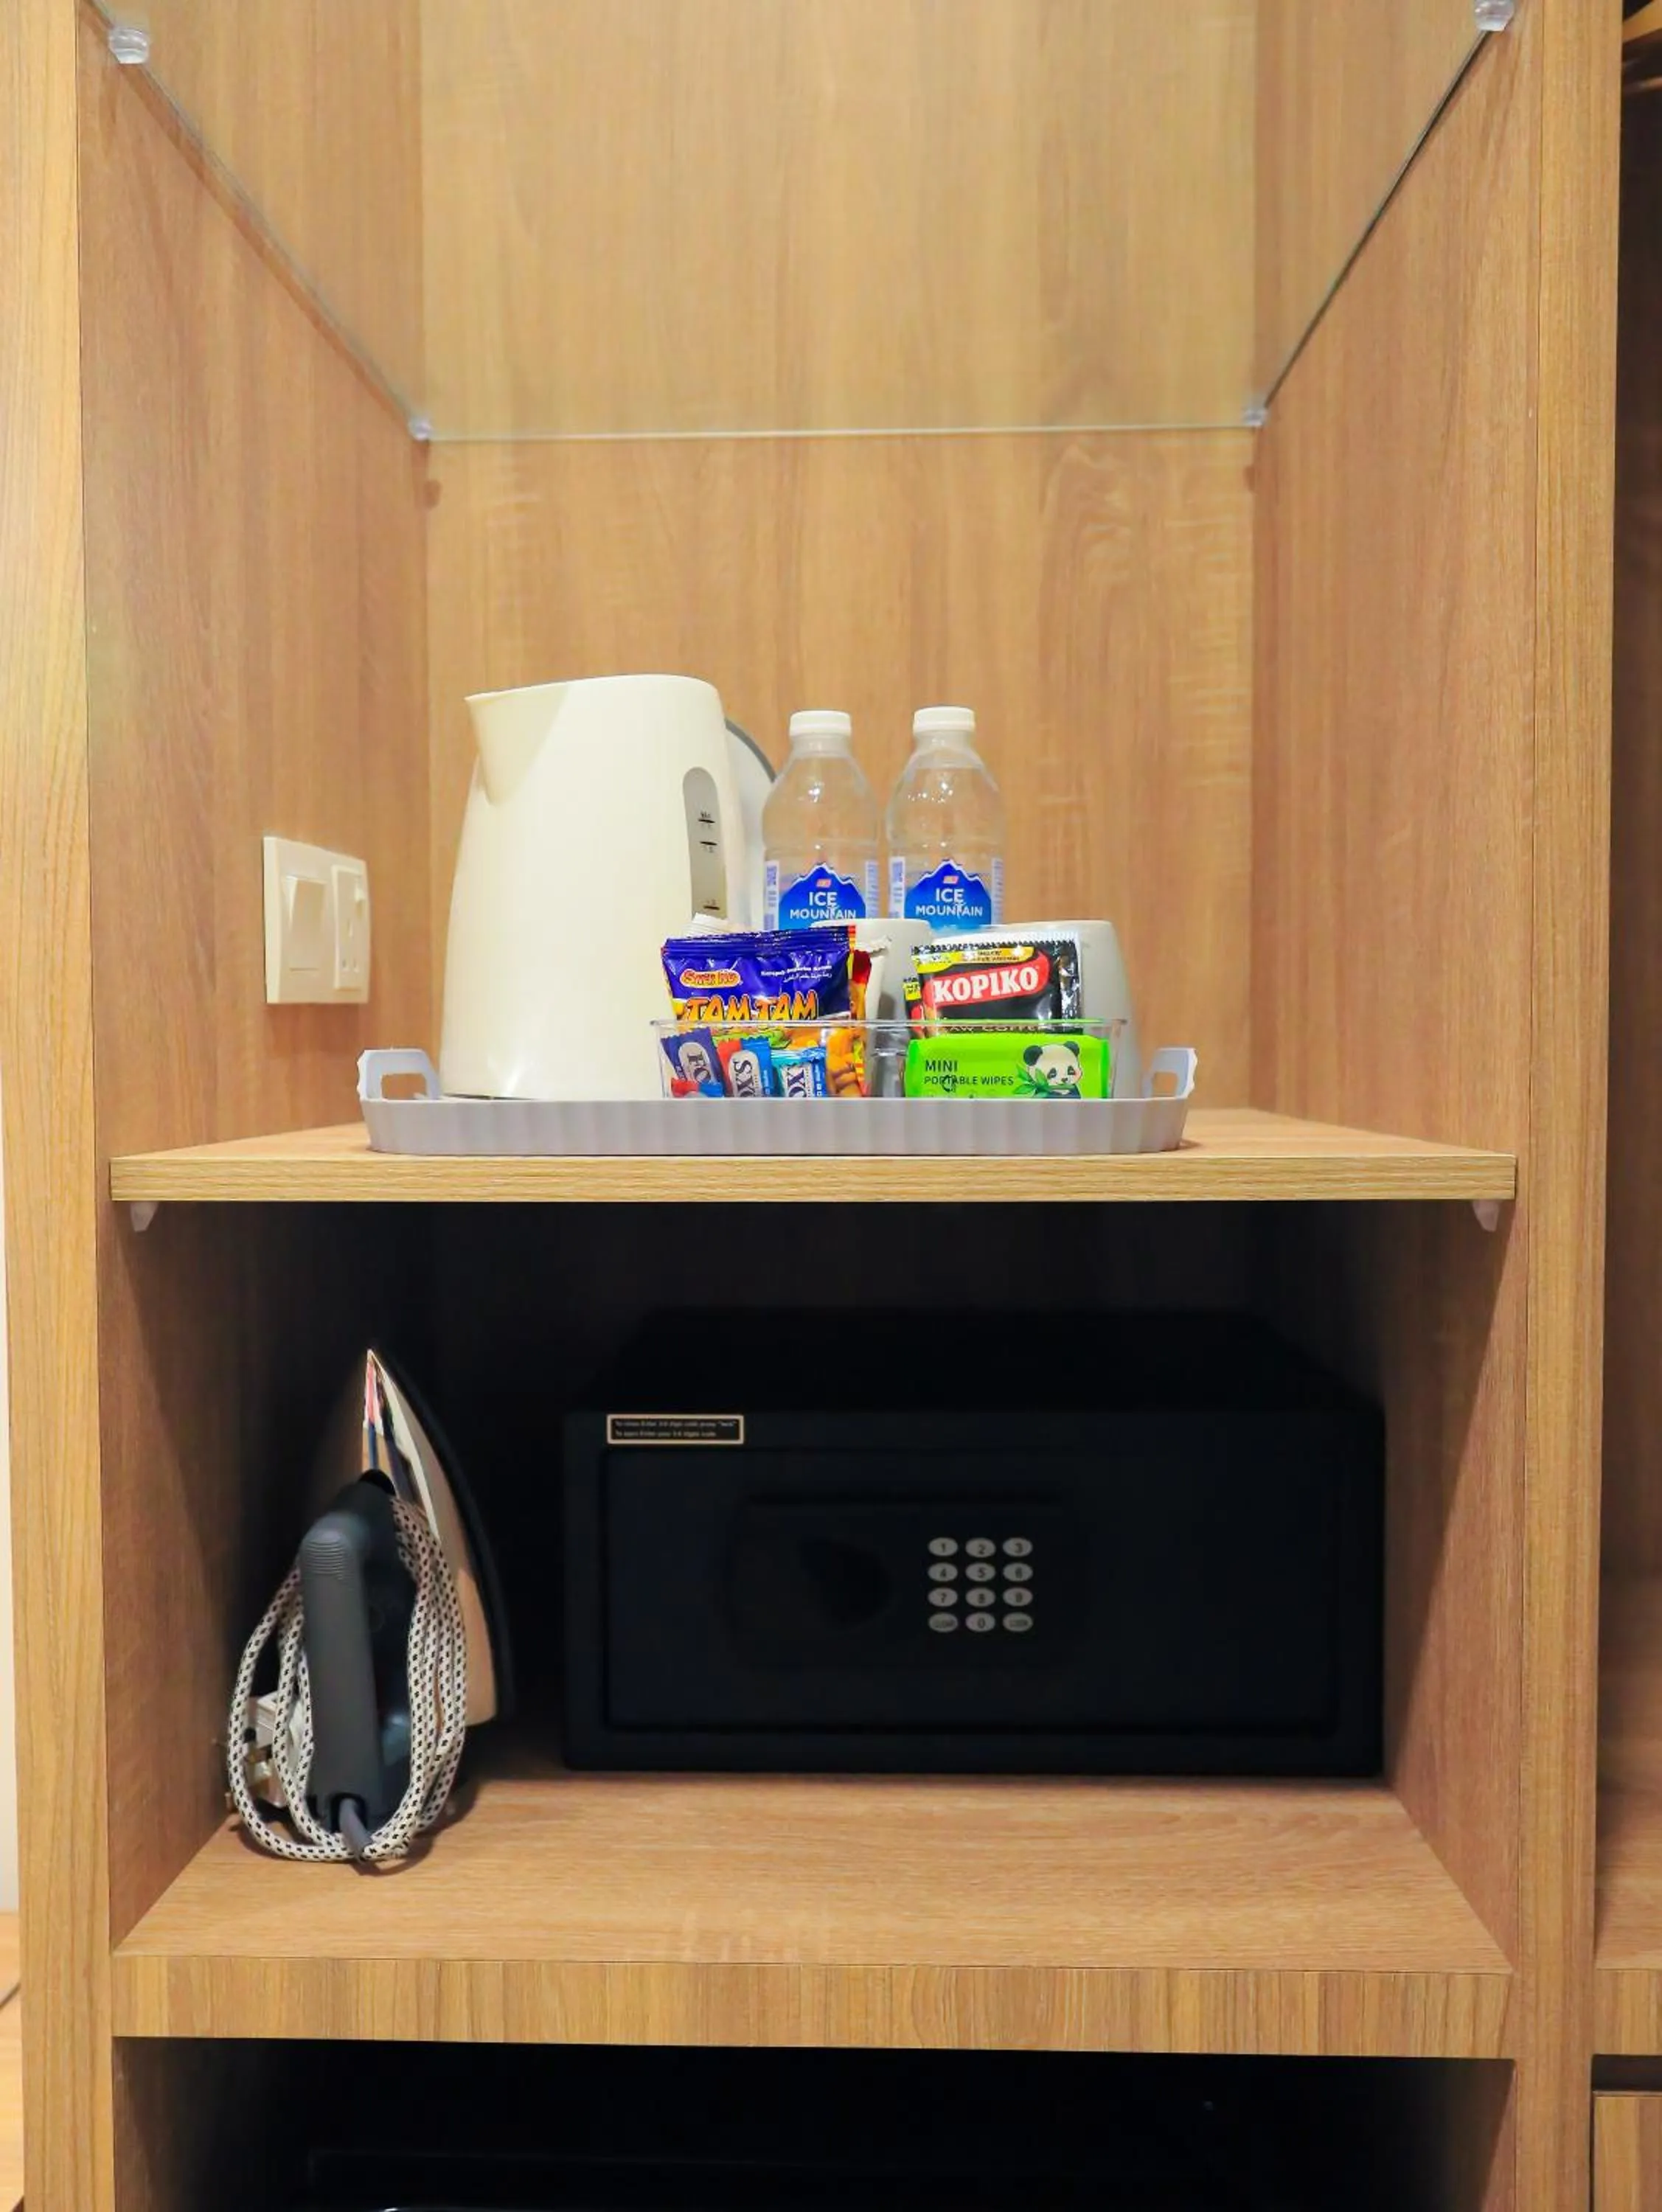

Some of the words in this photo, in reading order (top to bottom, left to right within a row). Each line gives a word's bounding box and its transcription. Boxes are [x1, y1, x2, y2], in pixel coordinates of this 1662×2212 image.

[809, 891, 838, 906] ICE
[936, 888, 965, 902] ICE
[790, 908, 856, 920] MOUNTAIN
[915, 905, 983, 917] MOUNTAIN
[933, 967, 1039, 1003] KOPIKO
[684, 994, 751, 1020] TAM
[754, 990, 818, 1020] TAM
[925, 1060, 958, 1072] MINI
[924, 1076, 978, 1085] PORTABLE
[981, 1076, 1015, 1085] WIPES
